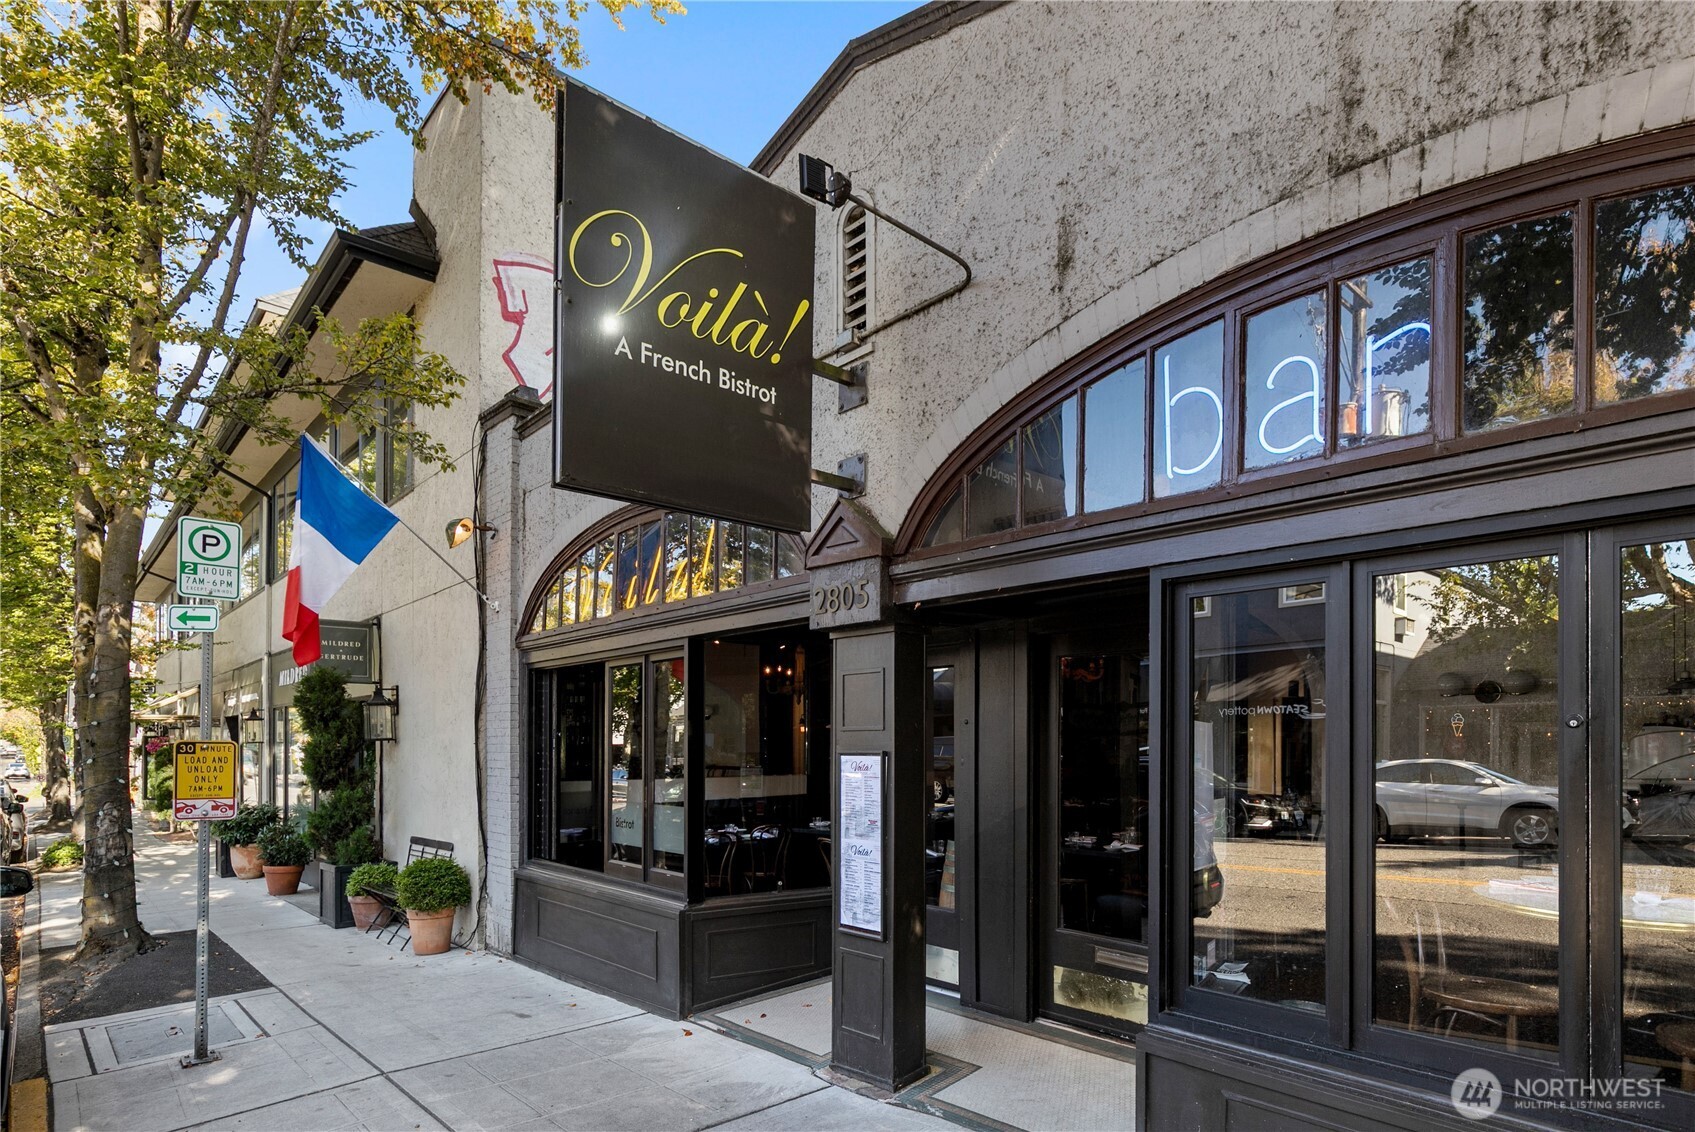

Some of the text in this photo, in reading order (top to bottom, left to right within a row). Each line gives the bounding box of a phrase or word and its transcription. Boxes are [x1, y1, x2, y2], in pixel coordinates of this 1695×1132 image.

[569, 209, 810, 364] Voilà!
[614, 336, 777, 404] A French Bistrot
[1163, 321, 1431, 479] bar
[202, 534, 220, 553] P
[184, 563, 233, 577] 2 HOUR
[186, 576, 233, 588] 7AM-6PM
[814, 580, 869, 615] 2805
[179, 744, 194, 753] 30
[184, 756, 229, 764] LOAD AND
[194, 775, 218, 783] ONLY
[615, 817, 634, 829] Bistrot
